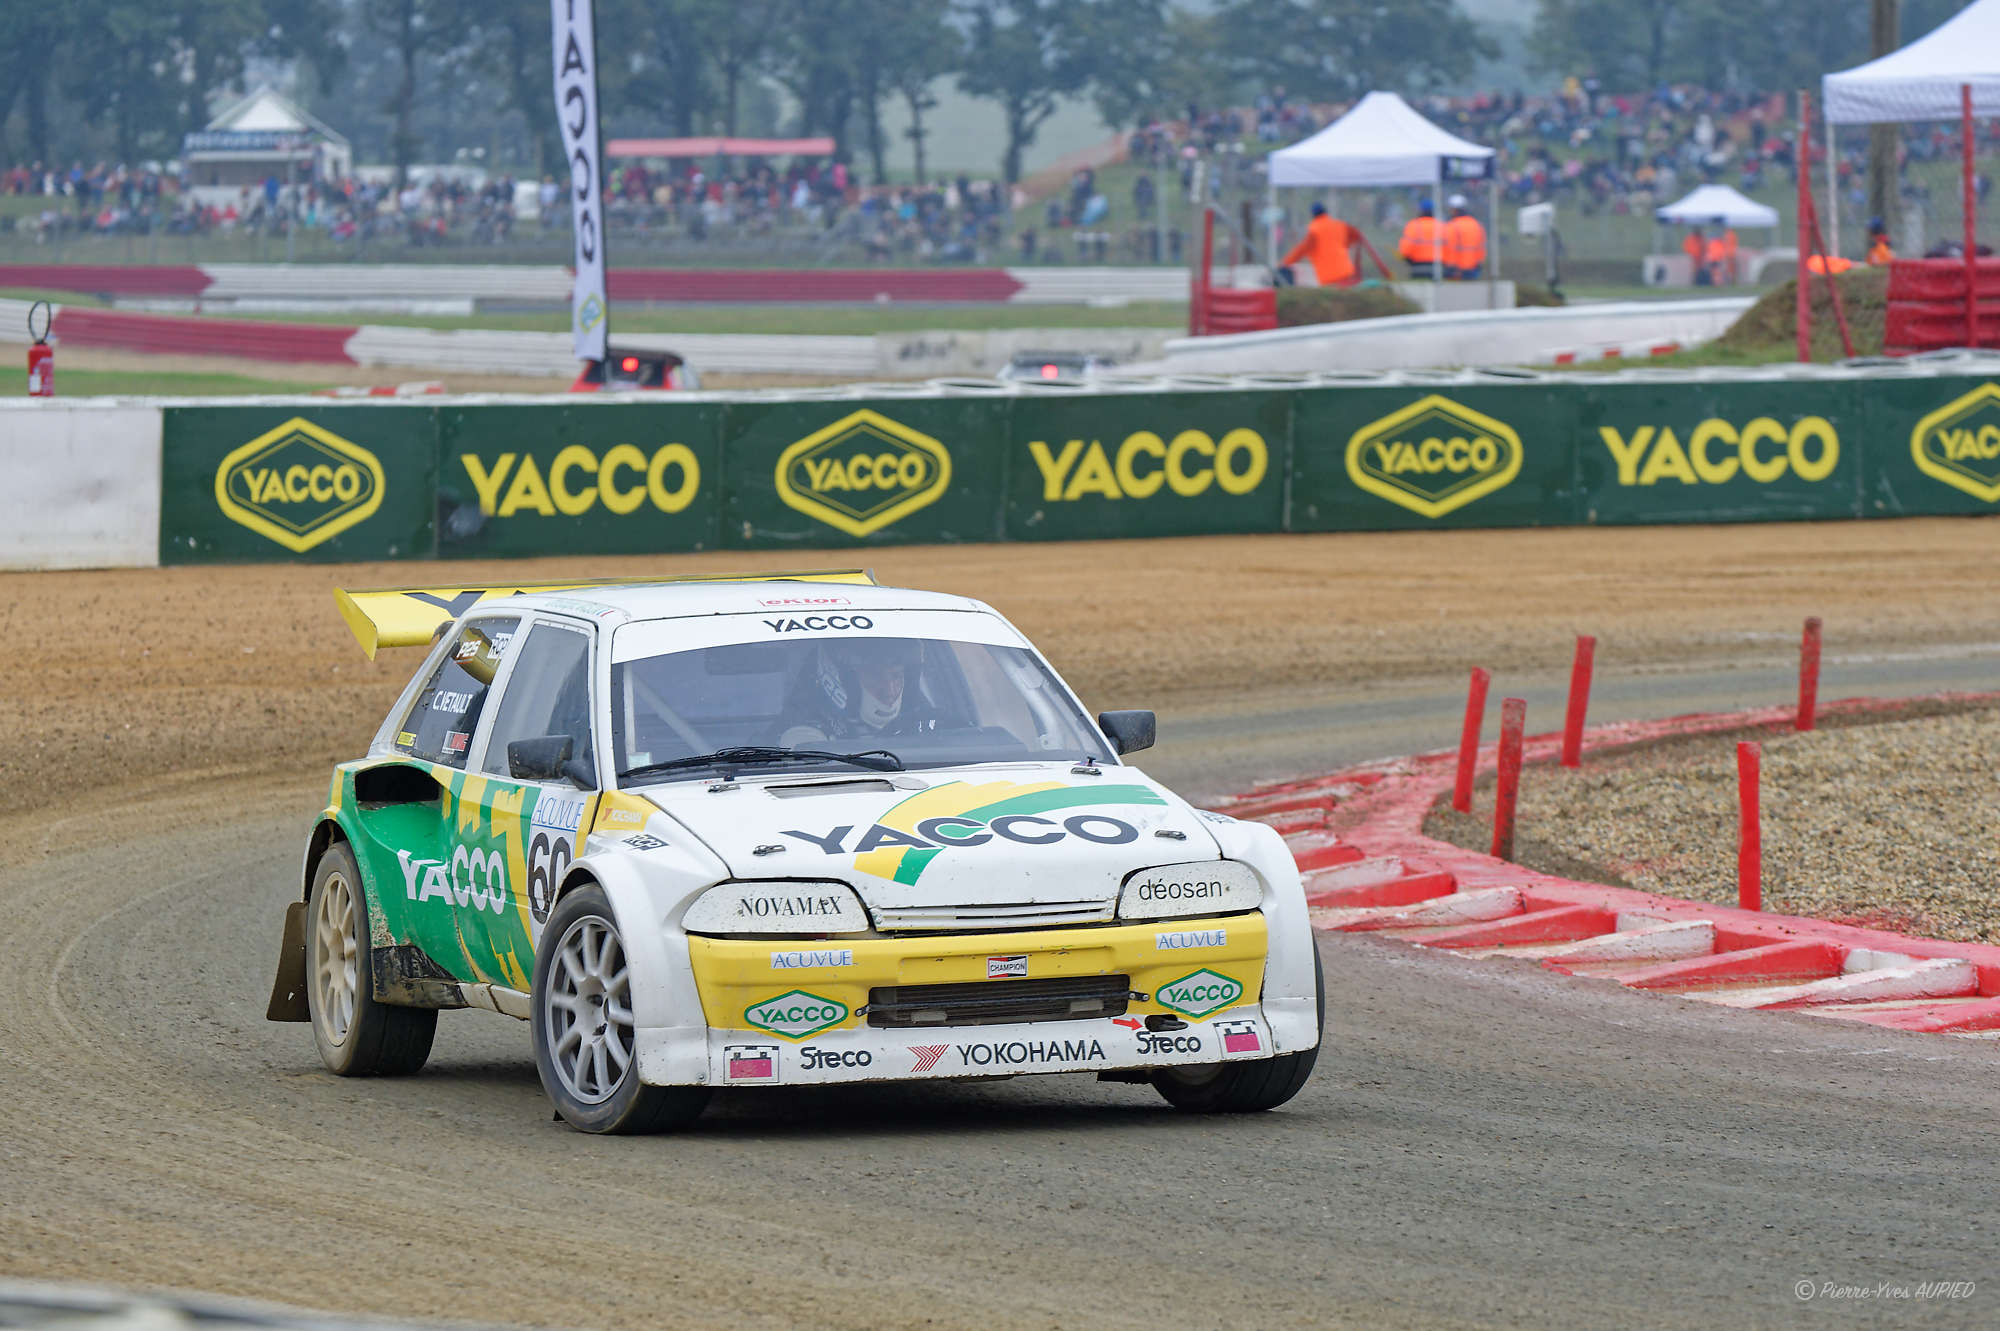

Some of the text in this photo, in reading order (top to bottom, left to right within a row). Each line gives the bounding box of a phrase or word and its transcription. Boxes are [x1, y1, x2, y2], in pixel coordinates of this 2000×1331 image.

[1374, 436, 1497, 473] YACCO
[1600, 416, 1839, 485] YACCO
[1936, 424, 2000, 460] YAC
[460, 443, 700, 517] YACCO
[803, 453, 926, 491] YACCO
[1029, 428, 1268, 501] YACCO
[243, 463, 361, 503] YACCO
[762, 615, 874, 633] YACCO
[531, 794, 585, 829] ACUVUE
[778, 814, 1139, 855] YACCO
[397, 843, 506, 915] YACCO
[527, 832, 572, 925] 60
[1139, 878, 1222, 901] déosan
[739, 895, 843, 917] NOVAMAX
[1157, 930, 1225, 950] ACUVUE
[773, 950, 852, 968] ACUVUE
[990, 963, 1025, 972] CHAMPION
[1168, 983, 1235, 1003] YACCO
[757, 1005, 838, 1023] YACCO
[800, 1046, 873, 1070] Steco
[956, 1039, 1106, 1066] YOKOHAMA
[1136, 1030, 1202, 1055] Steco
